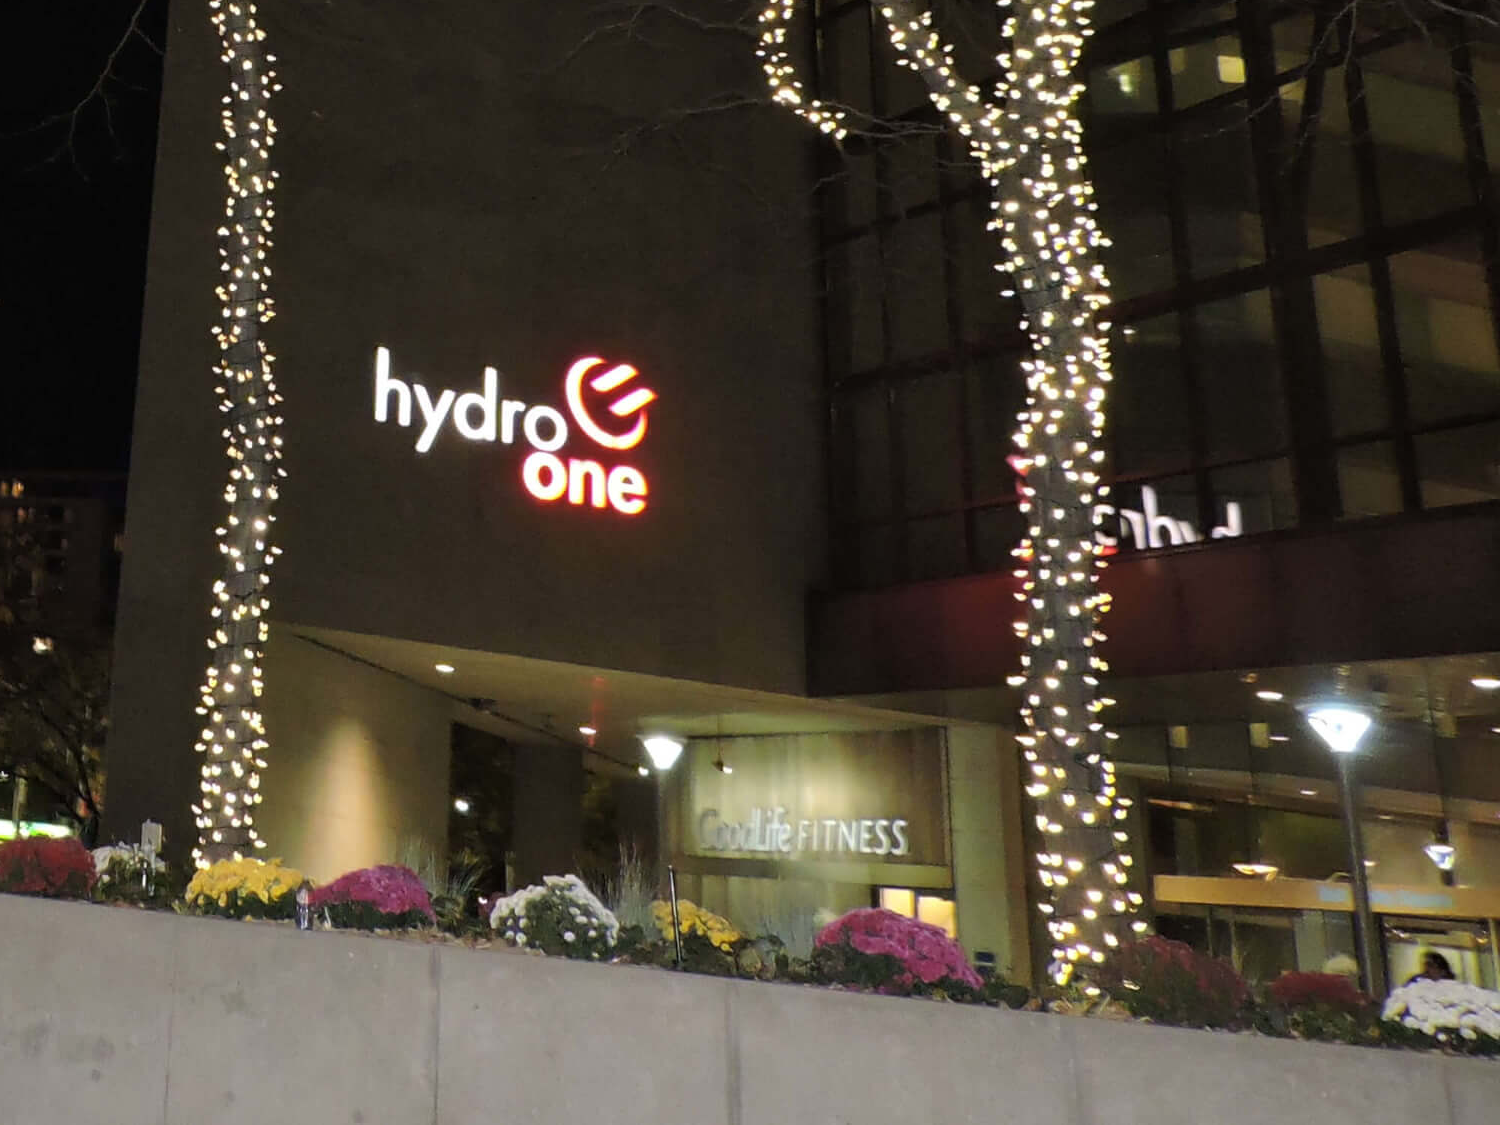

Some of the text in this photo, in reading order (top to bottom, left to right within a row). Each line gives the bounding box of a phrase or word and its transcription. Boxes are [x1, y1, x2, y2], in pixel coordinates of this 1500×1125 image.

[374, 346, 567, 452] hydro
[523, 451, 647, 514] one
[798, 819, 908, 855] FITNESS
